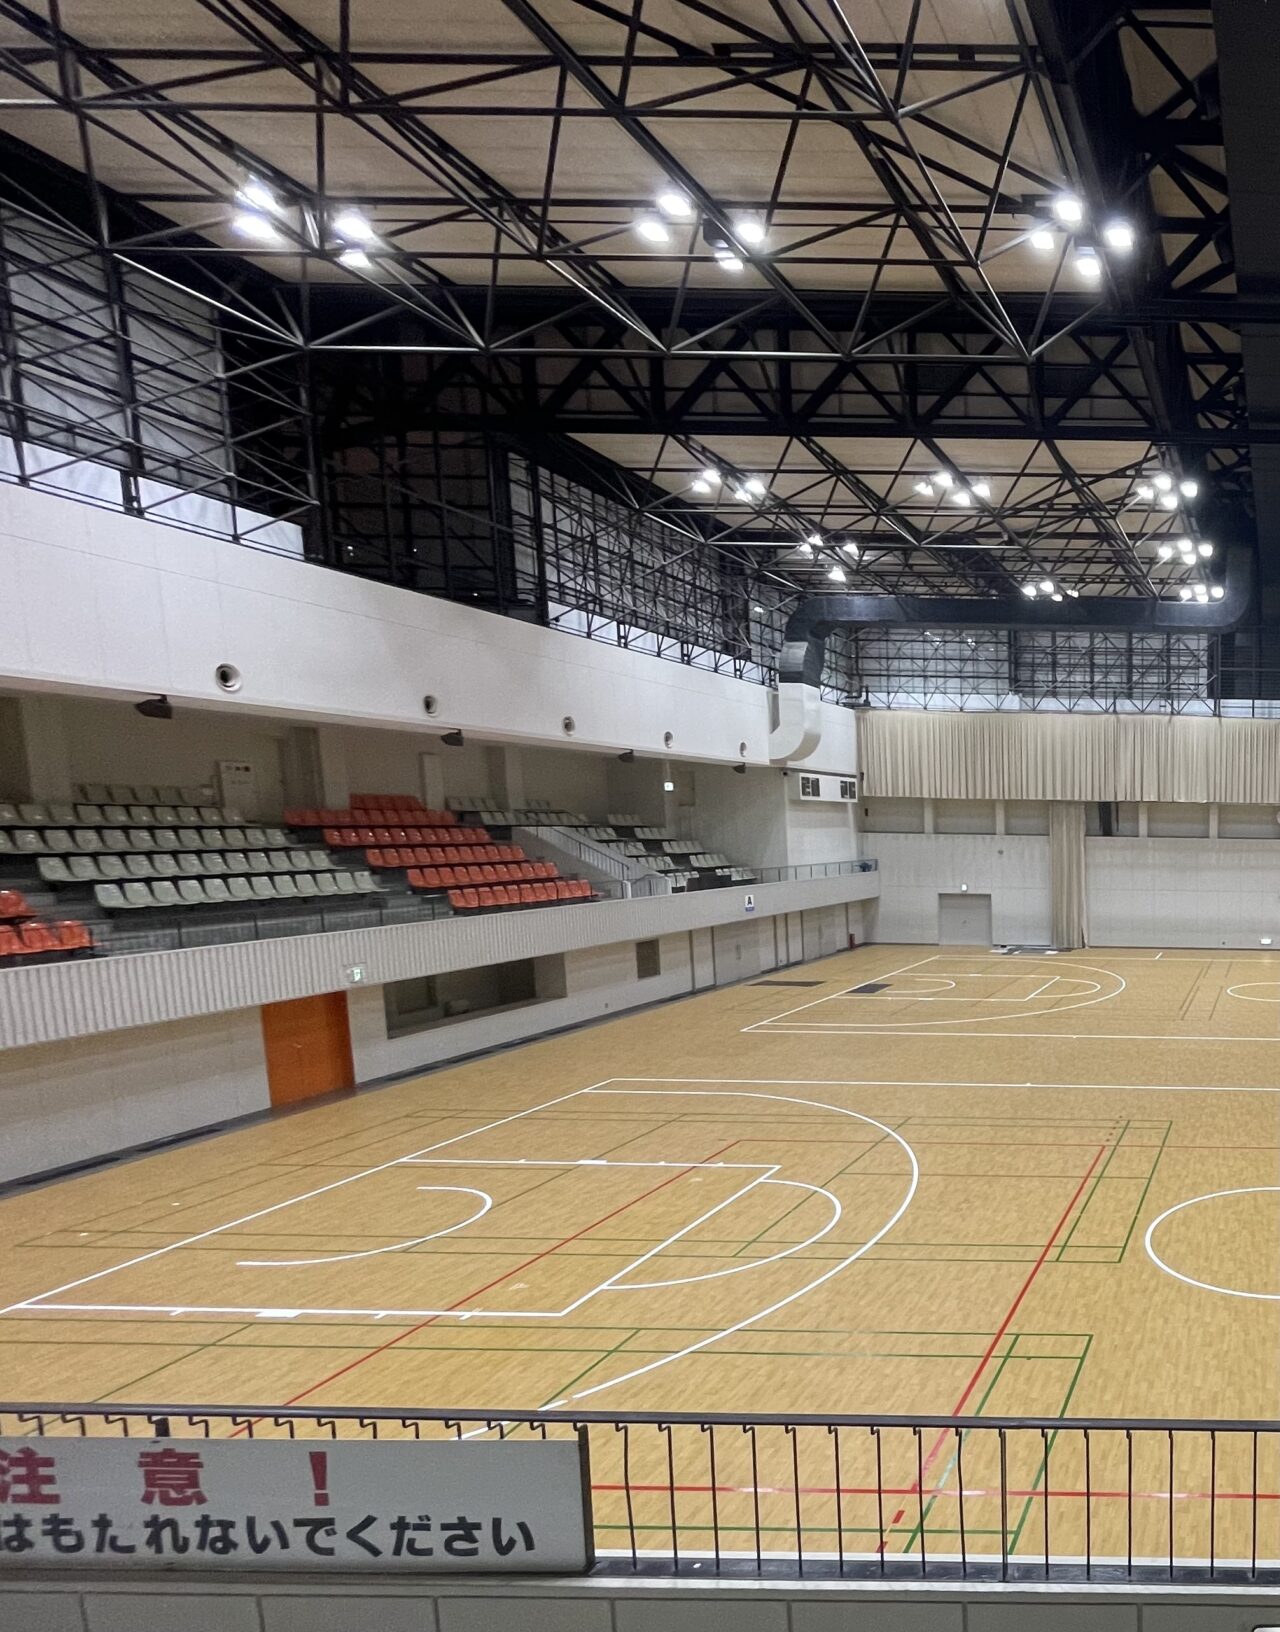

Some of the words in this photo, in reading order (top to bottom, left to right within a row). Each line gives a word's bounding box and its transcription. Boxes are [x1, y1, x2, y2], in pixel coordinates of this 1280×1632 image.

[0, 1513, 536, 1557] はもたれないでください
